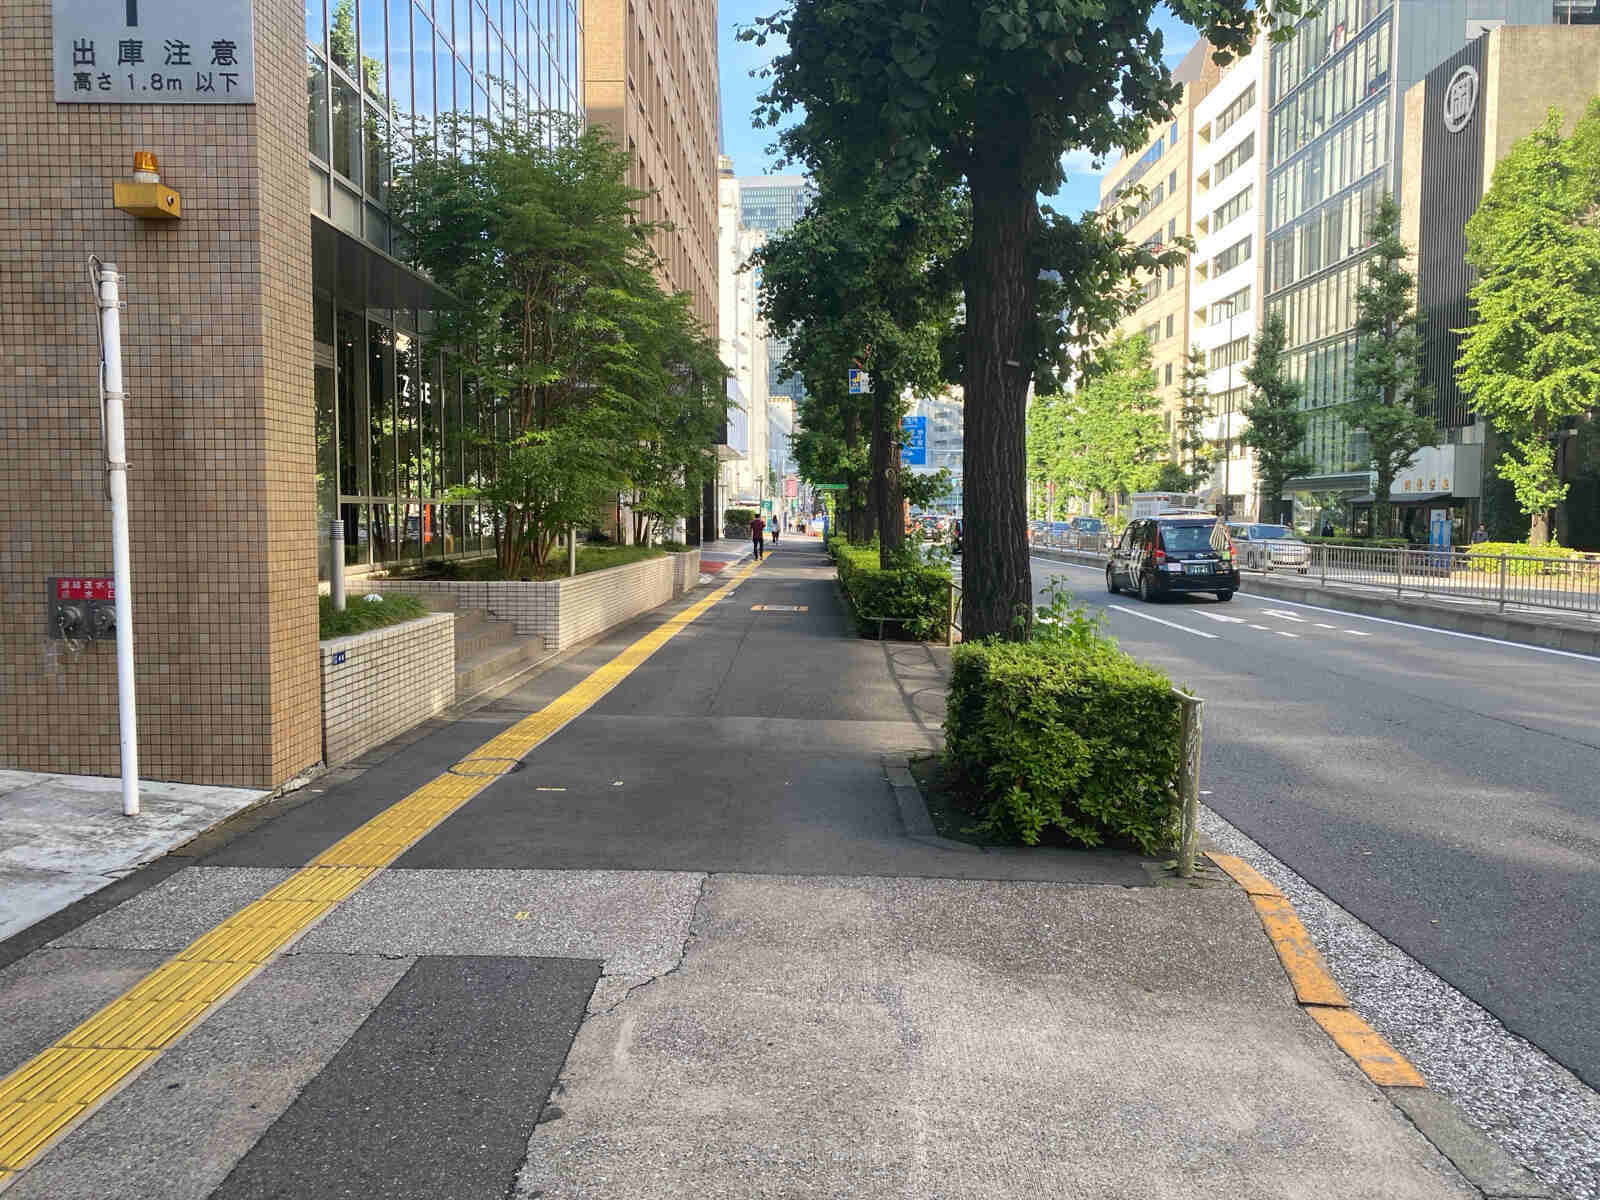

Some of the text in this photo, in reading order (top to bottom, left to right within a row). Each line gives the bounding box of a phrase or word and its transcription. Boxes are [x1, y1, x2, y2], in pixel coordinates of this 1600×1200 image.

[72, 38, 238, 67] 出庫注意
[73, 71, 239, 92] 高さ 1.8m 以下
